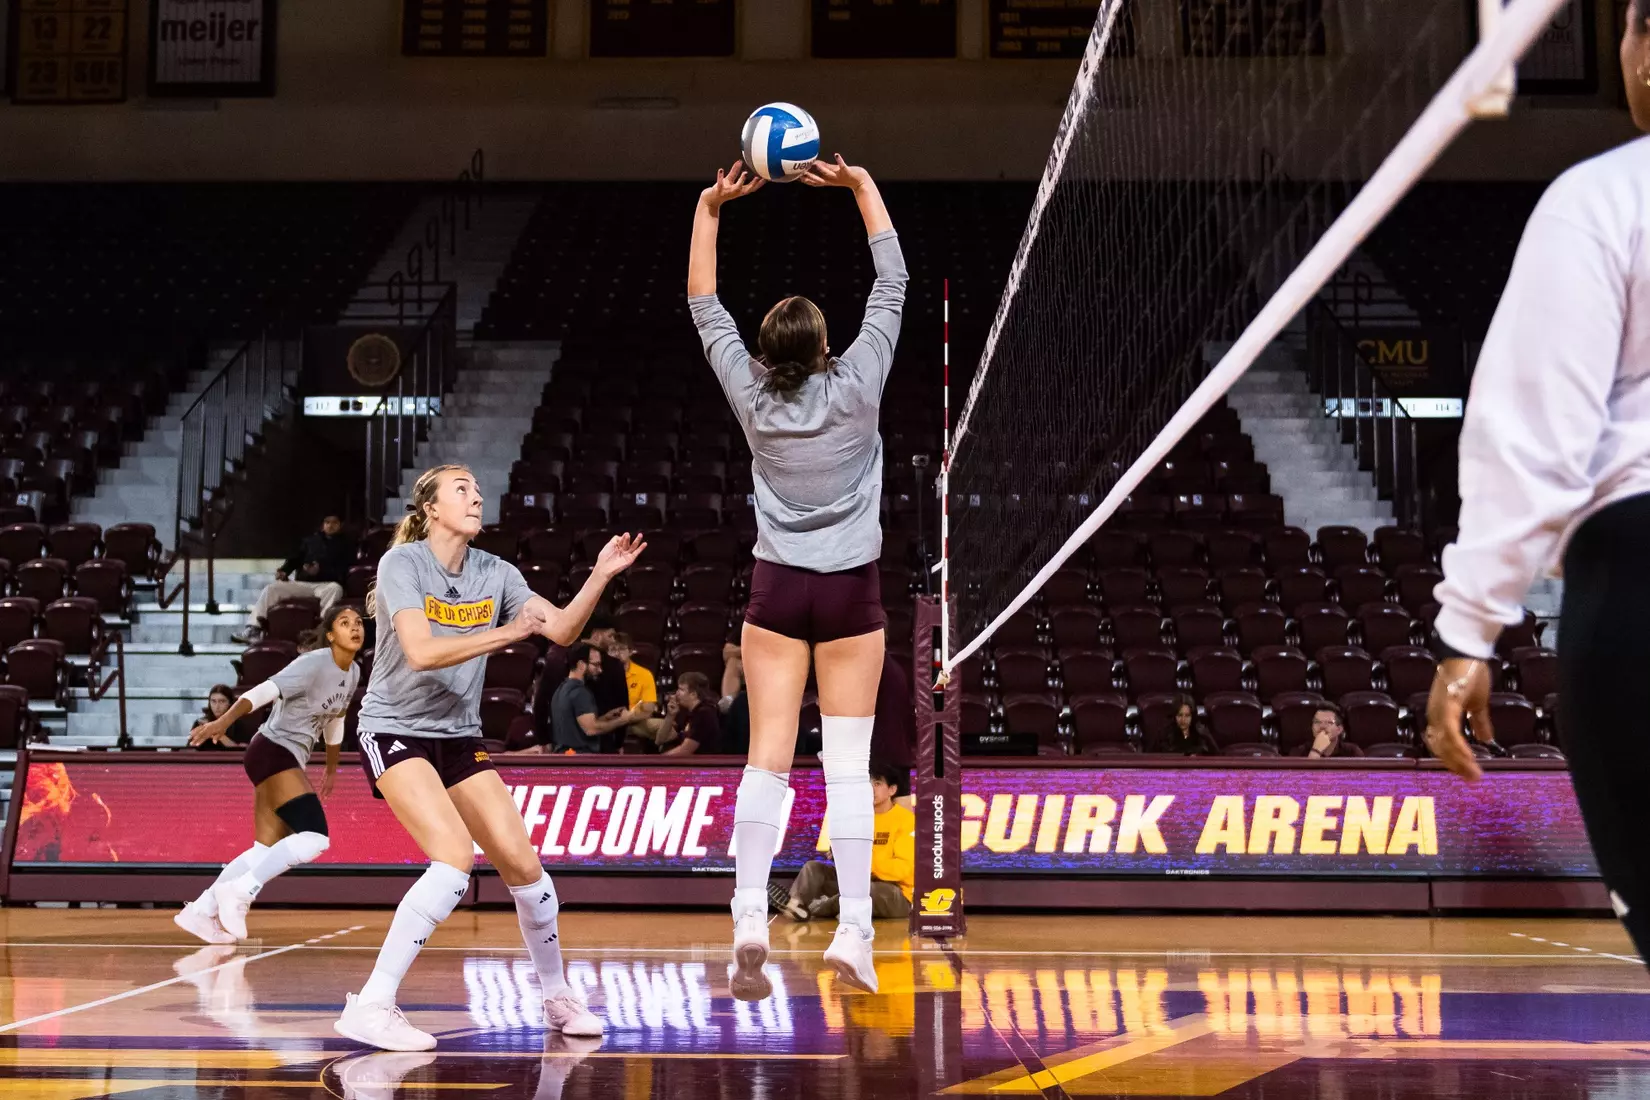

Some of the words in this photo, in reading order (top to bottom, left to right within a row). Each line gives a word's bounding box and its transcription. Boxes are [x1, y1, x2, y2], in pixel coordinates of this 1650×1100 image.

[32, 16, 58, 40] 13
[83, 16, 112, 40] 22
[161, 11, 259, 49] meijer
[1356, 339, 1428, 365] CMU
[458, 604, 492, 622] CHIPS!
[932, 794, 944, 832] sports
[1195, 795, 1439, 855] ARENA
[932, 833, 944, 879] imports
